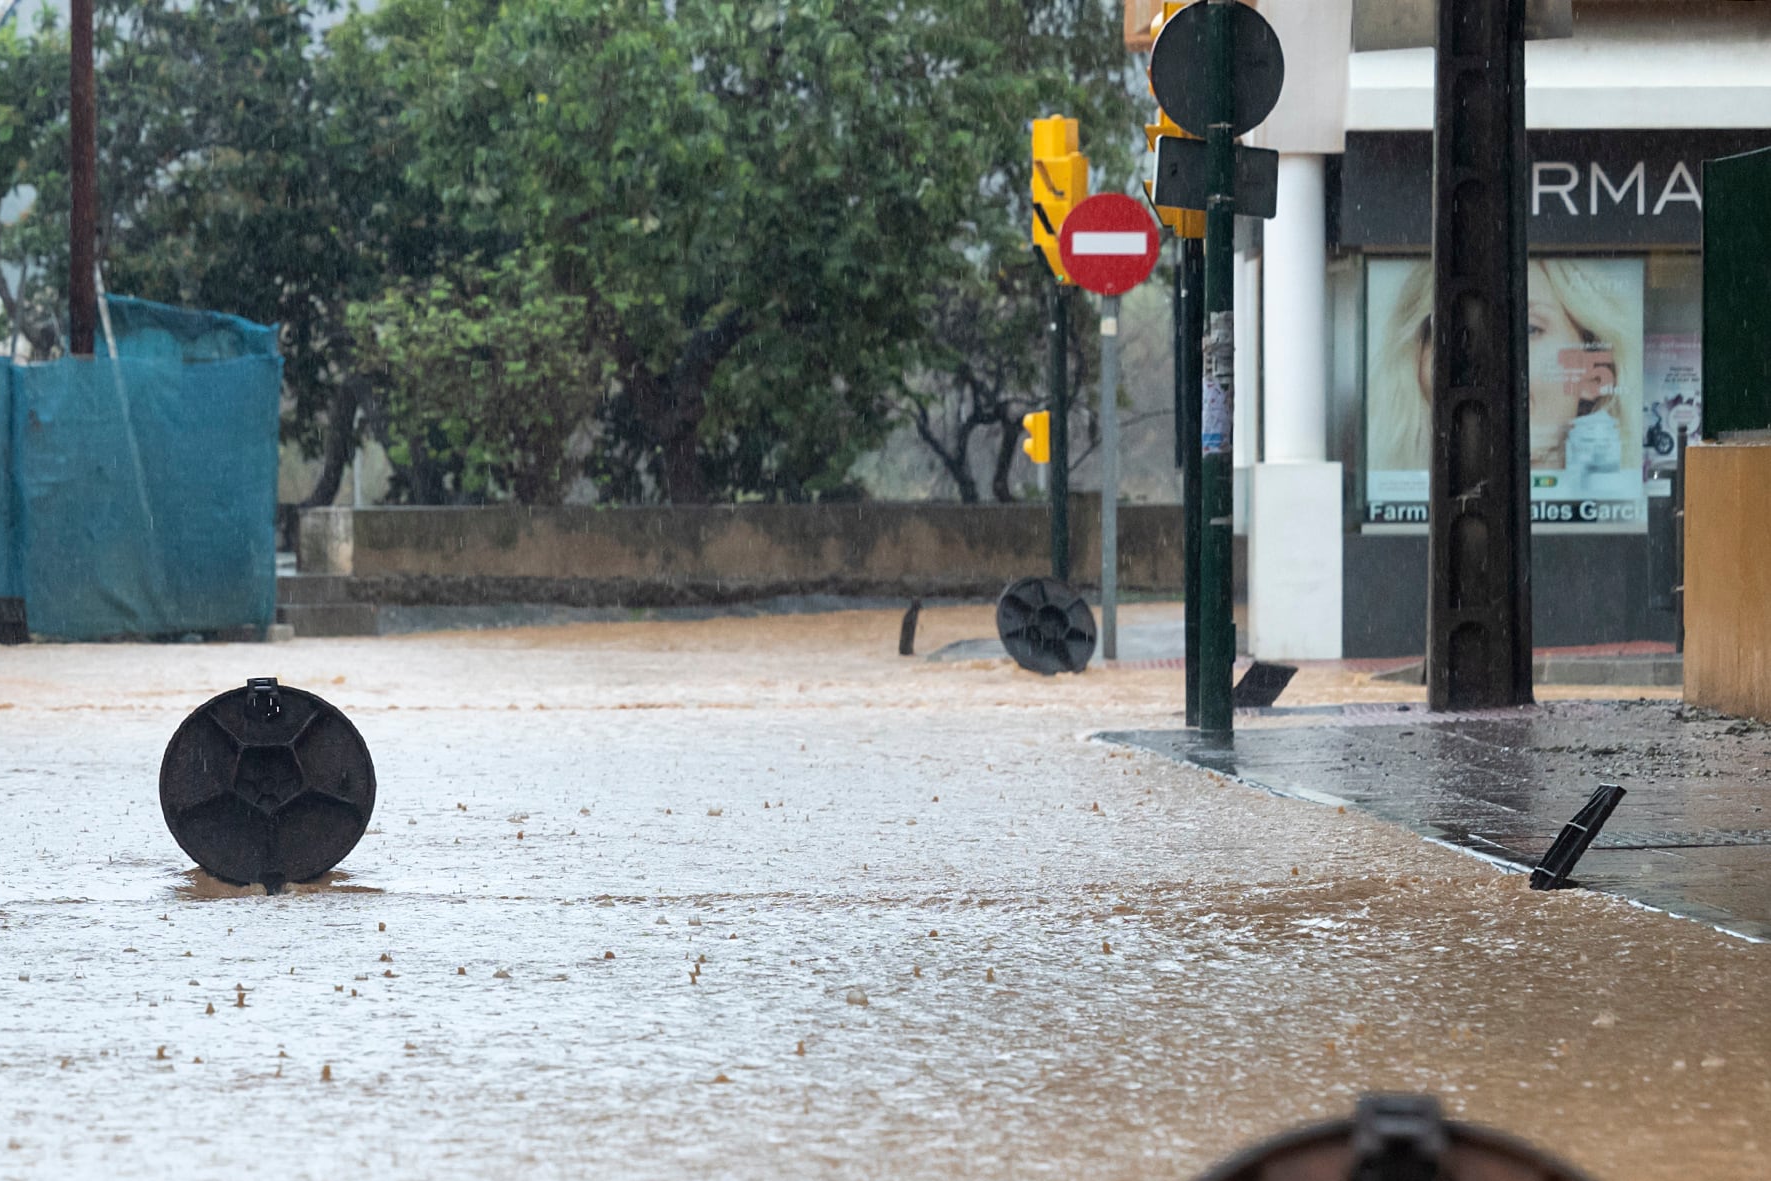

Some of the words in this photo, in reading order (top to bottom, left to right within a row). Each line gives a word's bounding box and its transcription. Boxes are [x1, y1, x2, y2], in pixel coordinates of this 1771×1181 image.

[1532, 161, 1702, 216] RMA
[1369, 501, 1428, 520] Farm
[1530, 501, 1573, 520] ales
